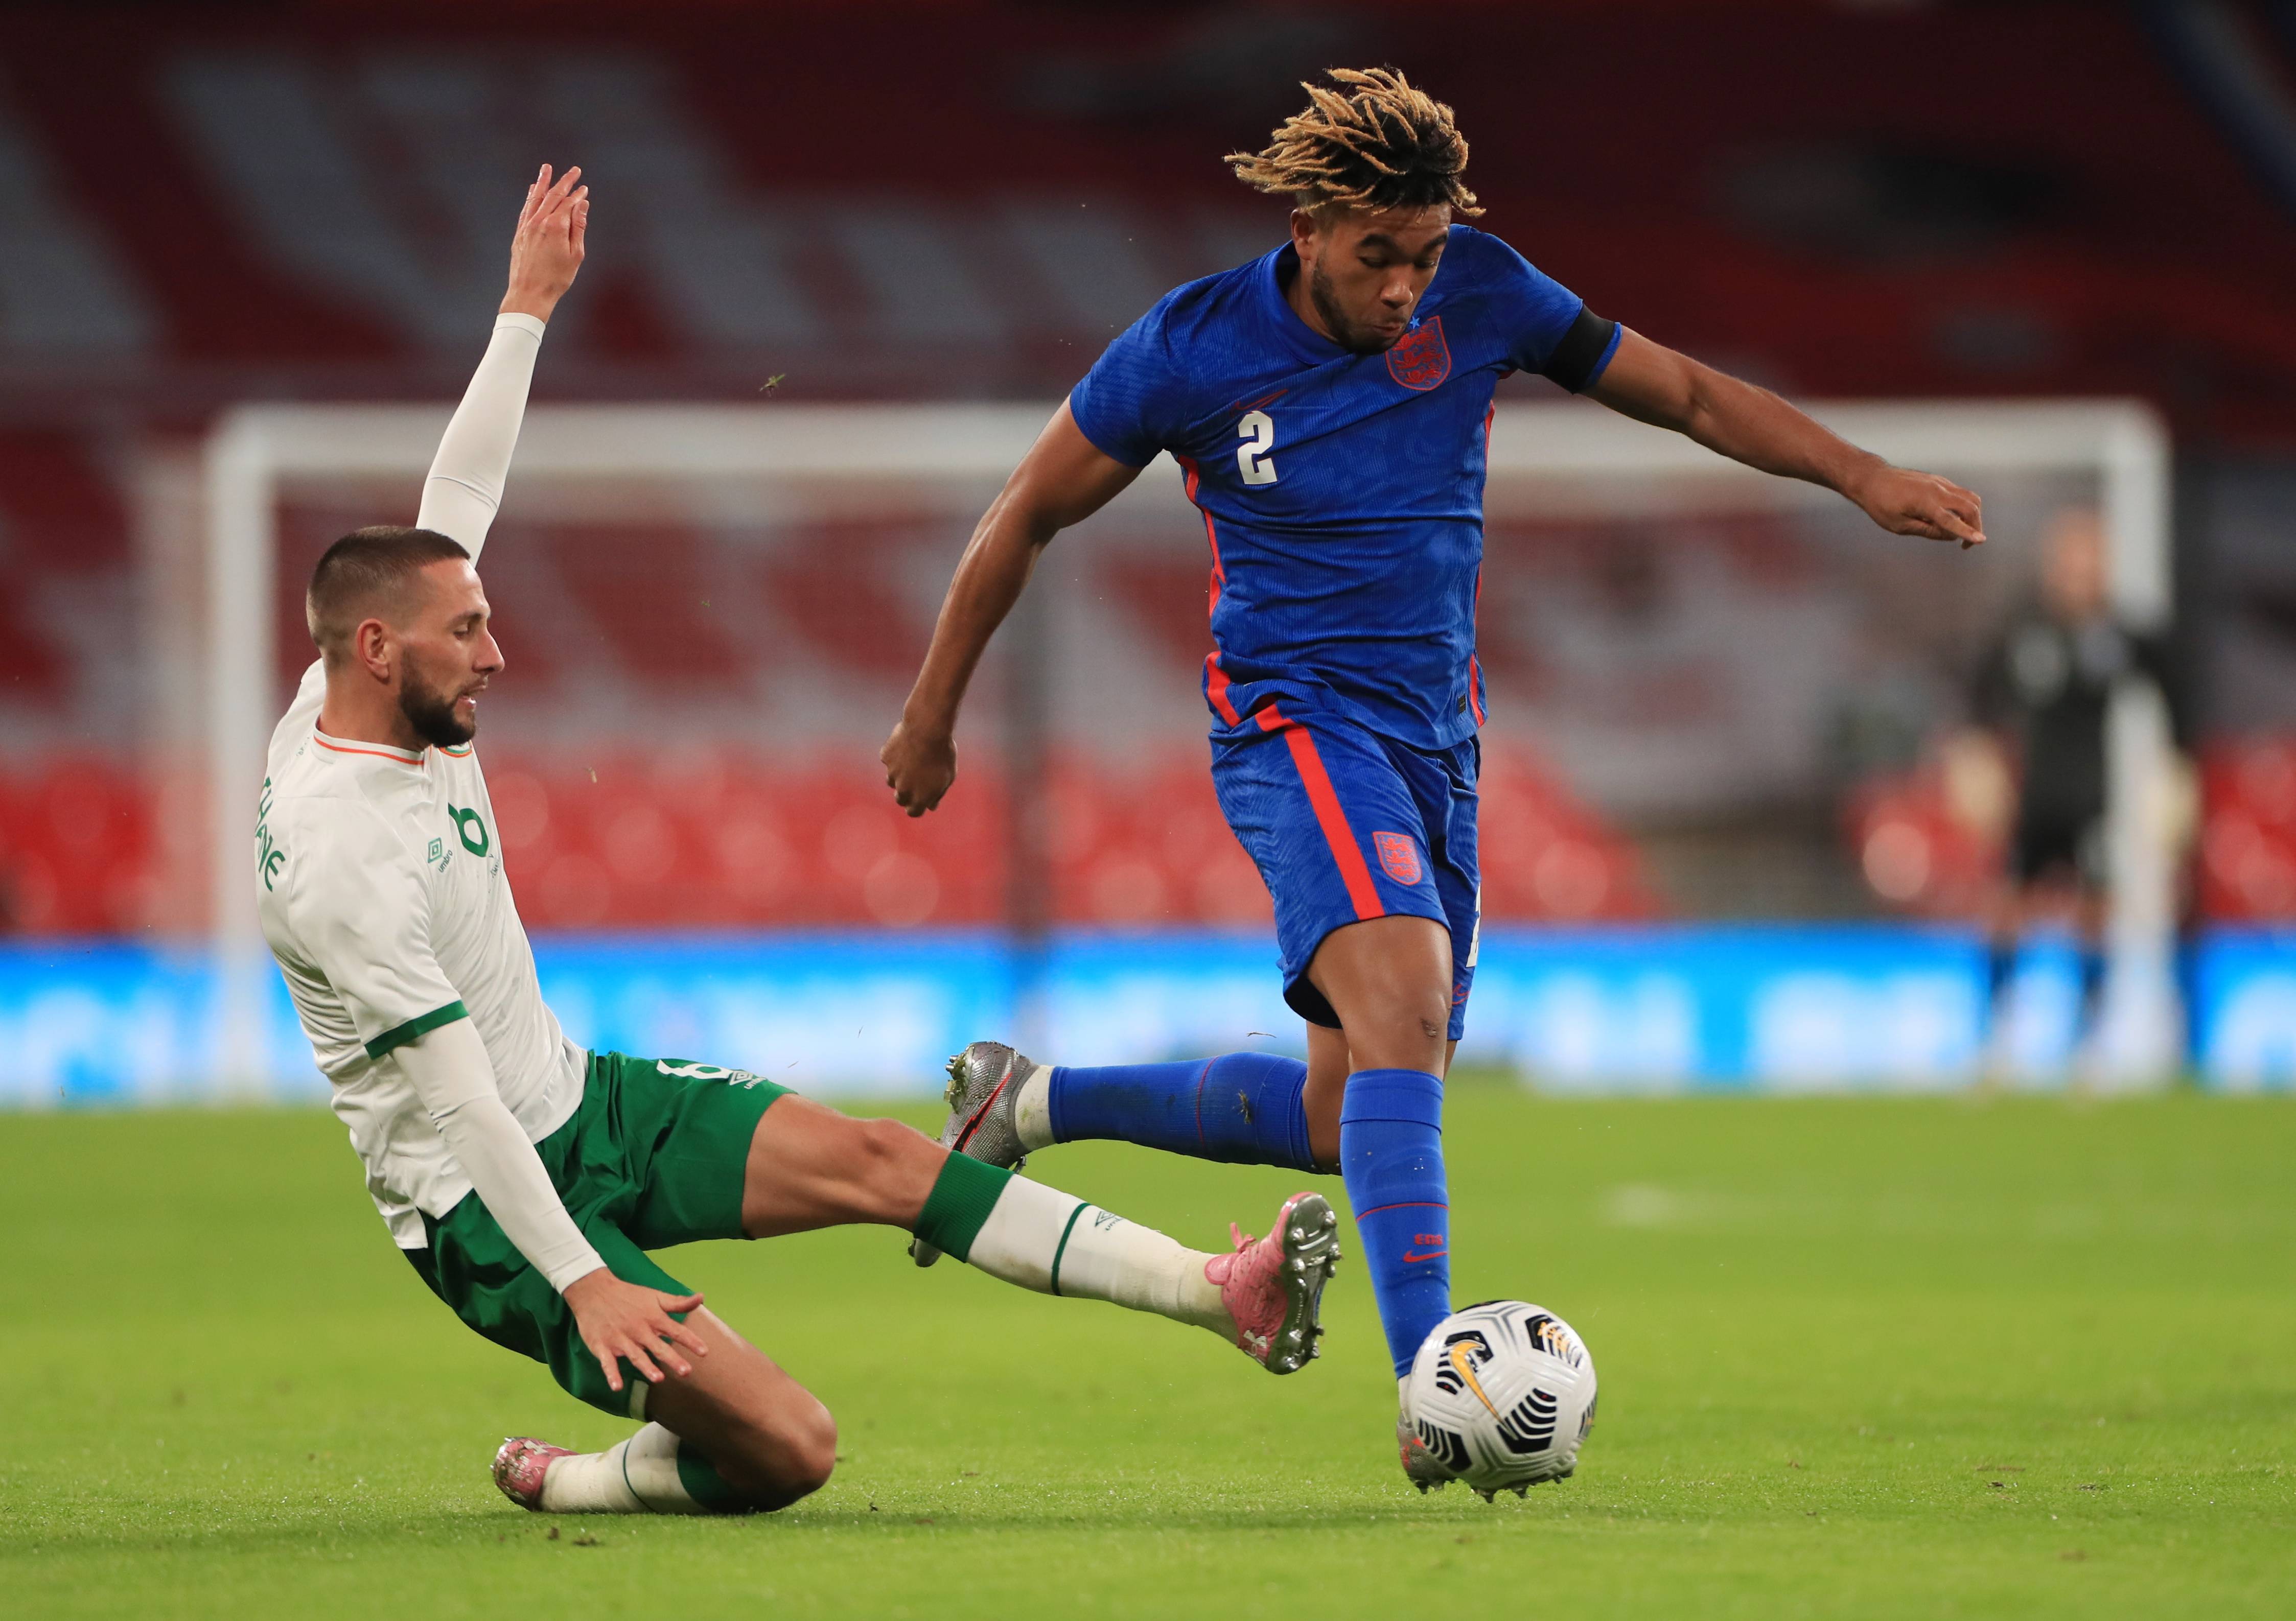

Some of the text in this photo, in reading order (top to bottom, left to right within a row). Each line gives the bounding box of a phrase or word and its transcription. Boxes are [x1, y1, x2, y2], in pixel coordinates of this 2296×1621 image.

[1237, 410, 1278, 484] 2
[448, 802, 489, 857] 6
[438, 850, 453, 873] umbro
[656, 1059, 733, 1079] 6
